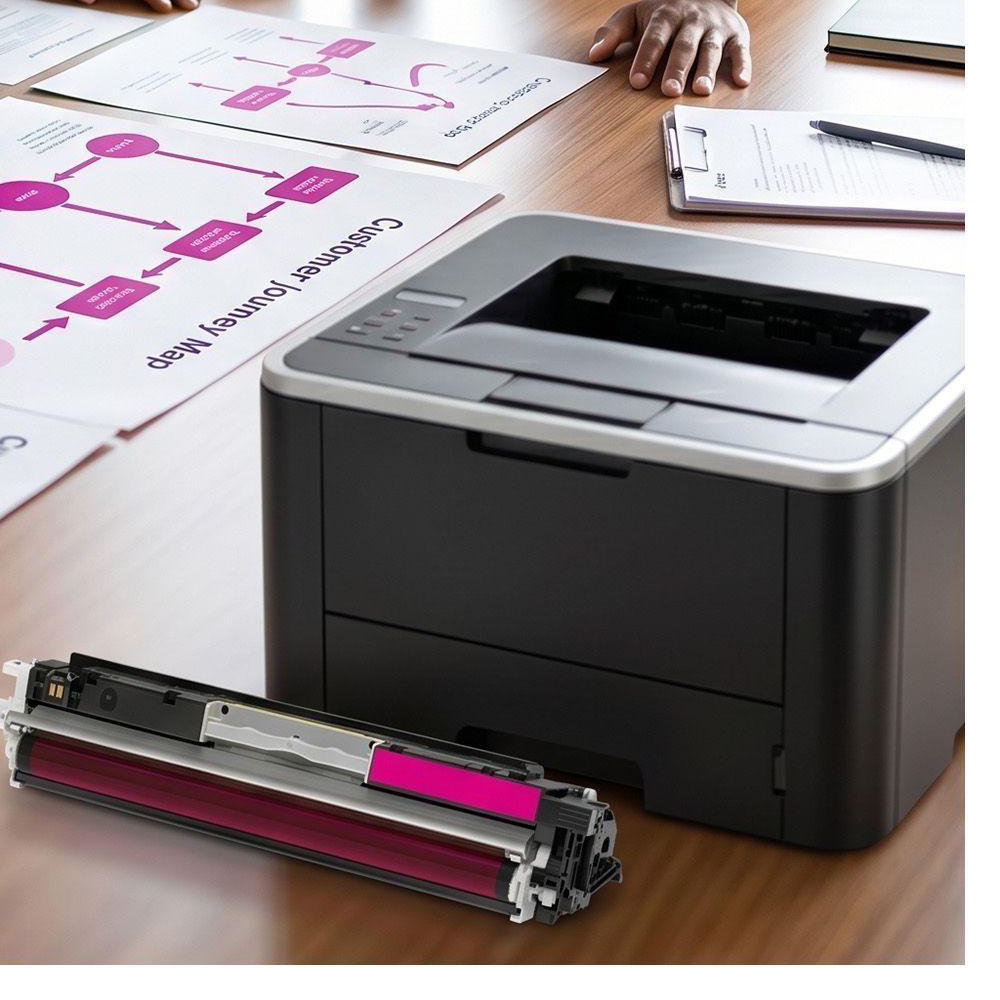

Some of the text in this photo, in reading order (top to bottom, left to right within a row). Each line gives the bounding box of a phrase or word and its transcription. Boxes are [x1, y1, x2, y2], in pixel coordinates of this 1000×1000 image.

[290, 217, 403, 282] Customer
[199, 280, 302, 337] Journey
[146, 338, 212, 370] Map
